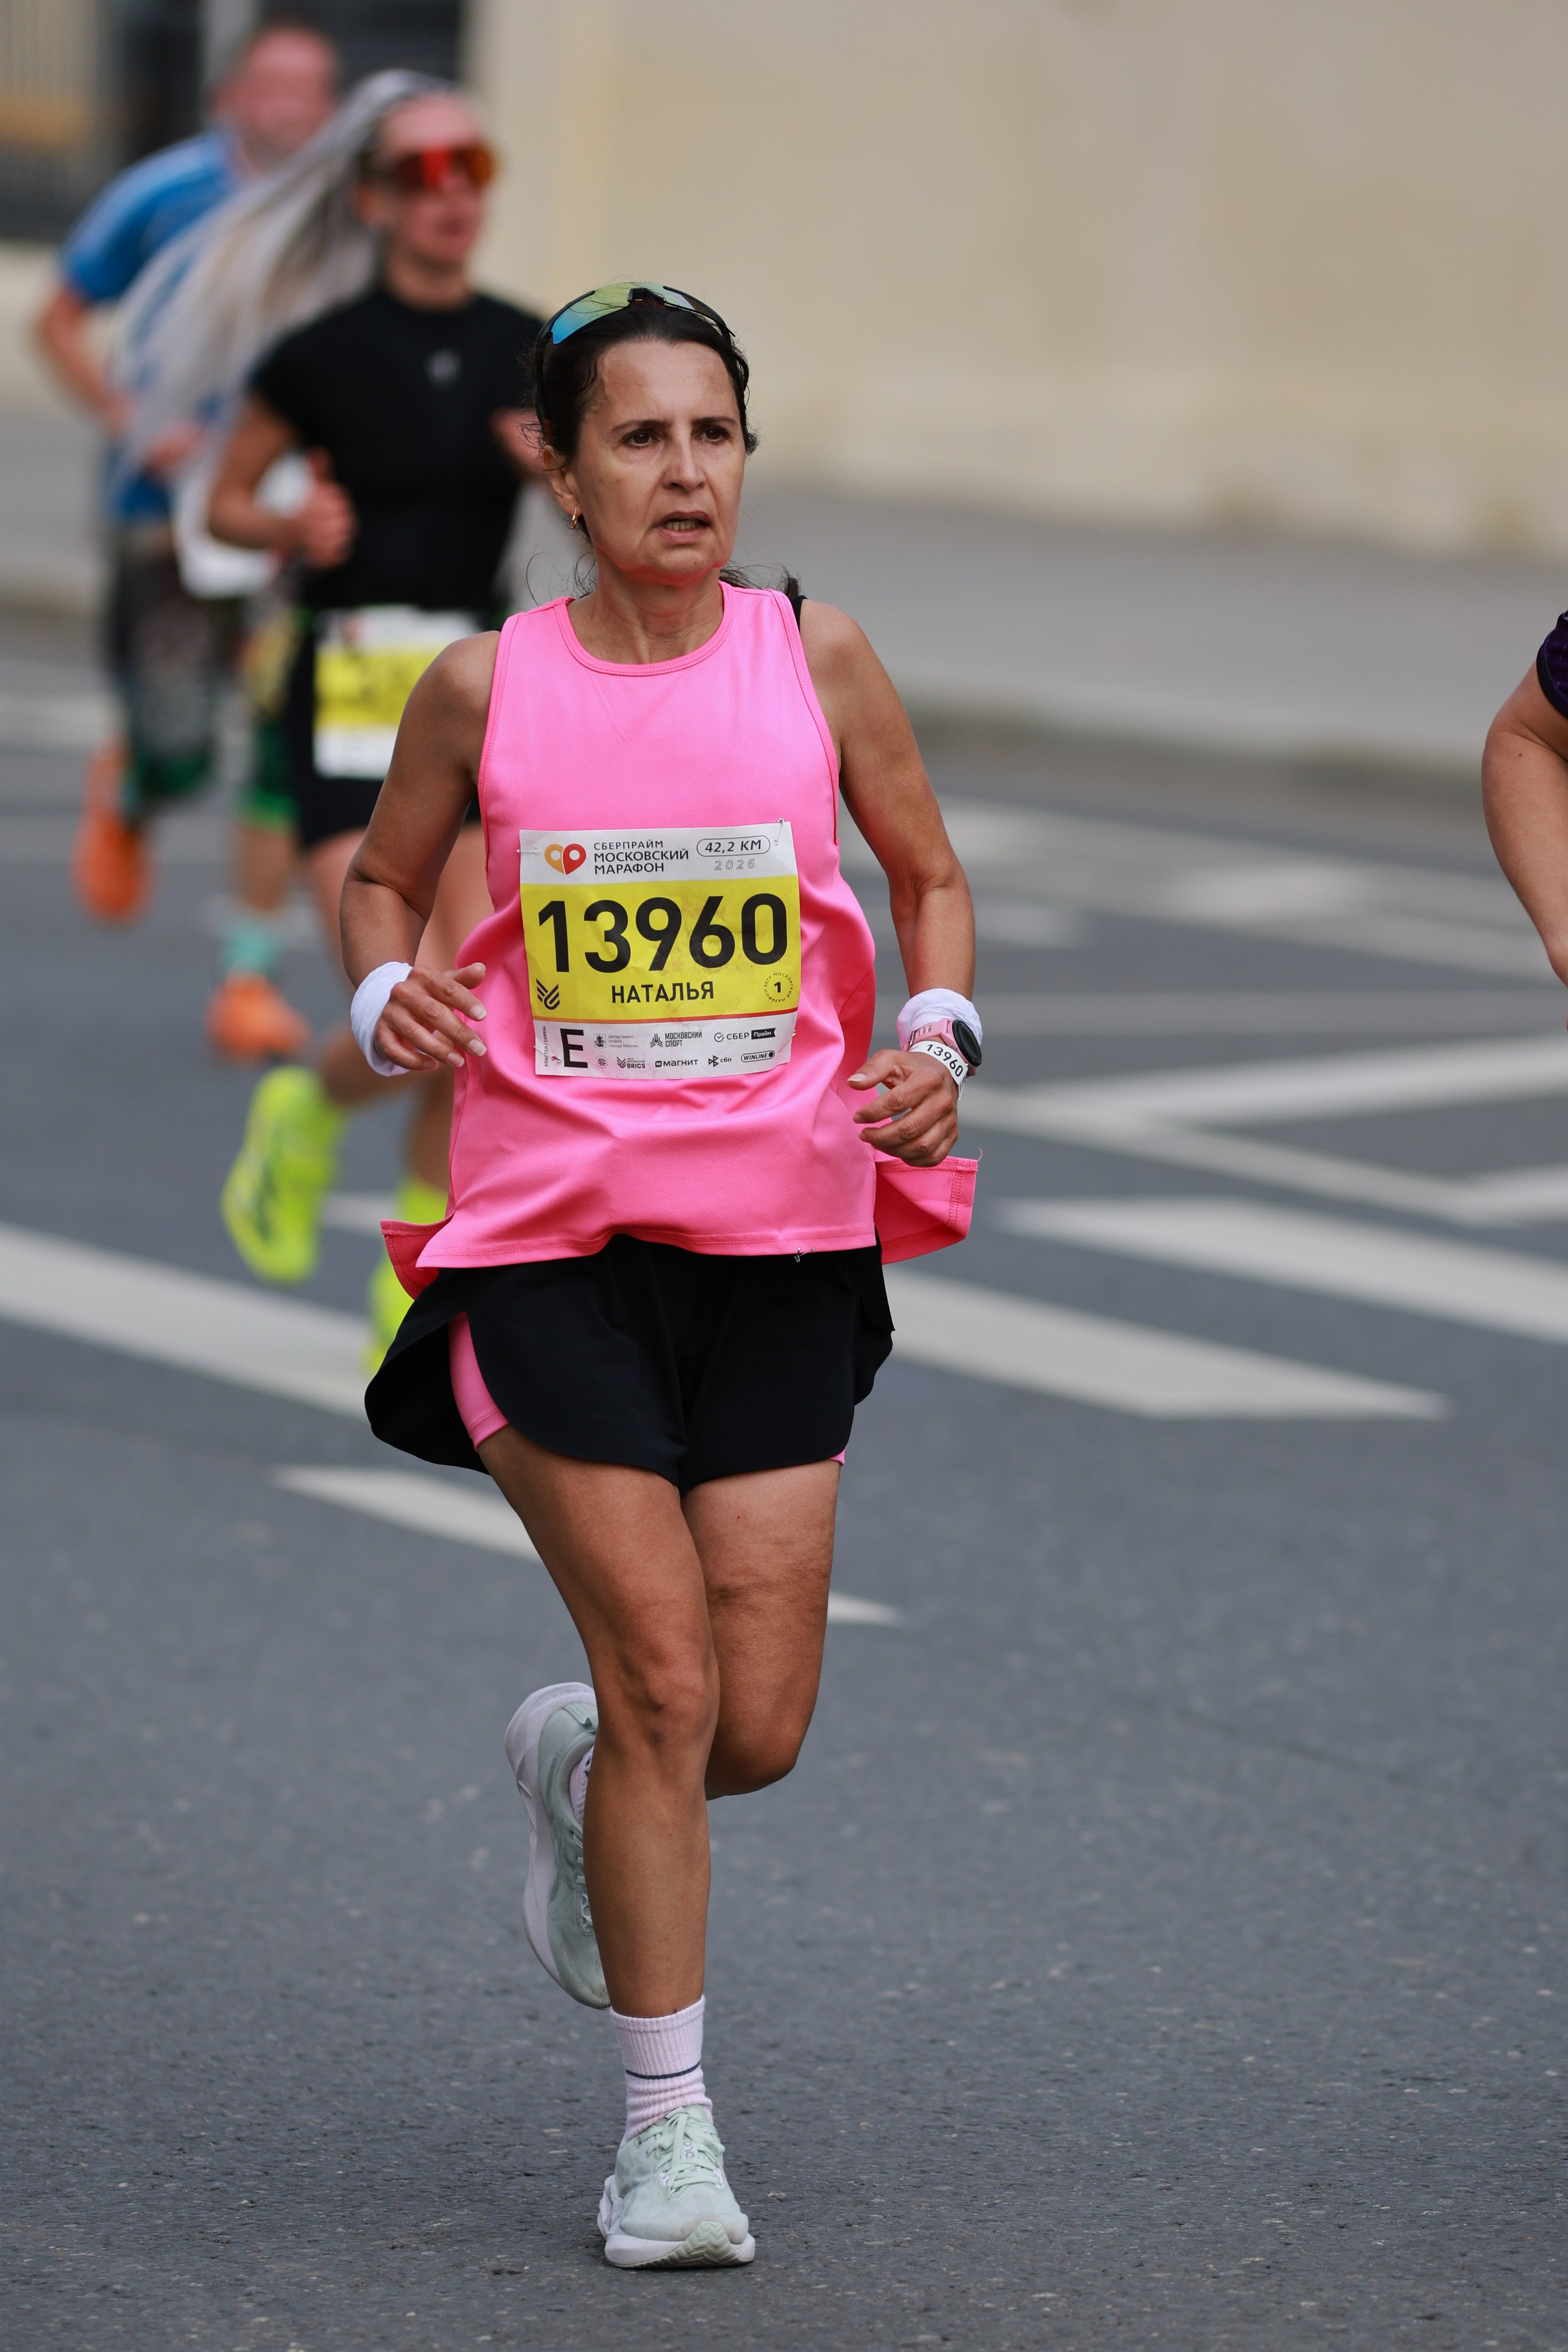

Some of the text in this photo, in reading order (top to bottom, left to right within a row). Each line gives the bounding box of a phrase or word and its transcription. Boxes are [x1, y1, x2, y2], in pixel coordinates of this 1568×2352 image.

[594, 839, 664, 850] СБЕРПРАЙМ
[704, 841, 736, 854] 42,2
[594, 849, 690, 862] МОСКОВСКИЙ
[595, 862, 665, 875] МАРАФОН
[714, 859, 756, 871] 2026
[538, 893, 788, 973] 13960
[773, 972, 794, 998] МОСКОВСКИЙ
[774, 981, 782, 993] 1
[612, 981, 714, 1004] НАТАЛЬЯ
[764, 989, 786, 1003] МАРАФОН
[665, 1029, 703, 1040] МОСКОВСКИЙ
[744, 1052, 768, 1061] WINLINE
[927, 1044, 963, 1077] 13960
